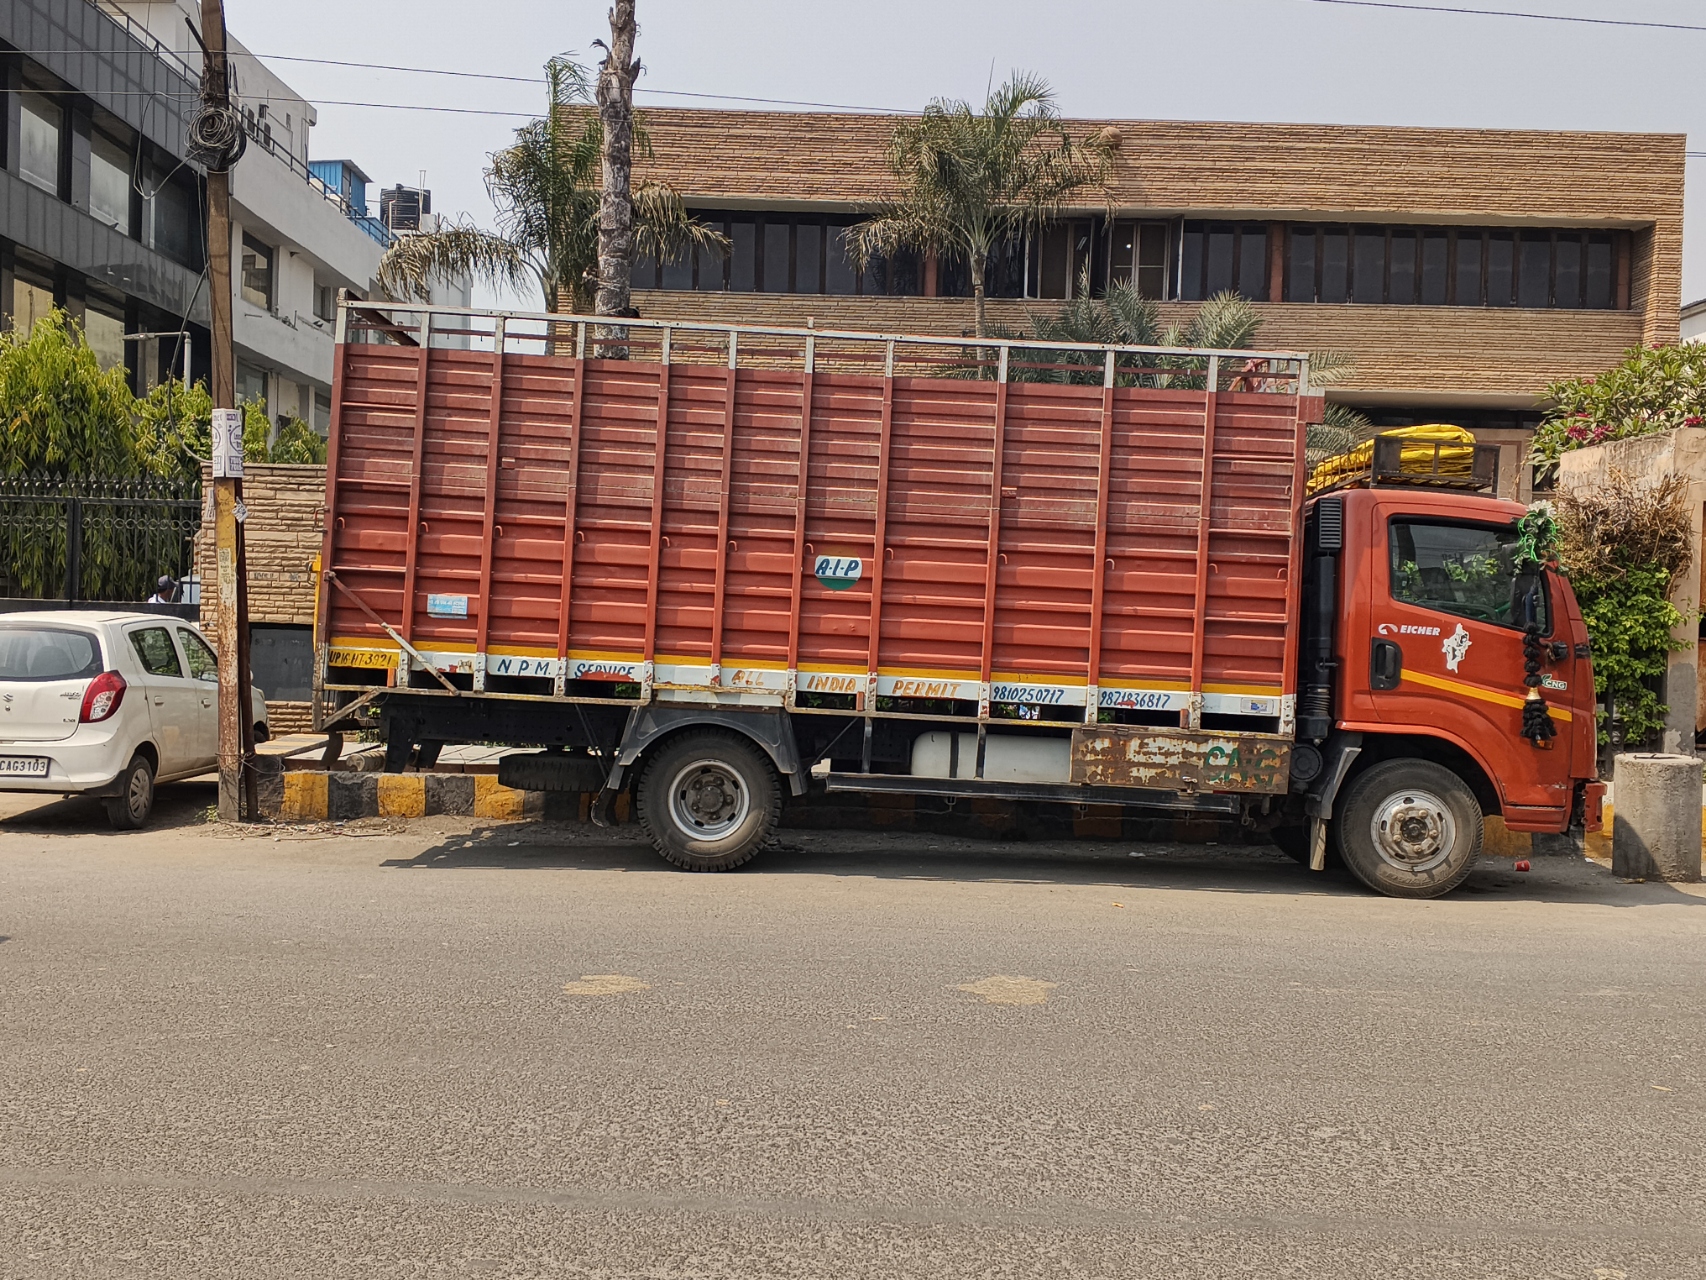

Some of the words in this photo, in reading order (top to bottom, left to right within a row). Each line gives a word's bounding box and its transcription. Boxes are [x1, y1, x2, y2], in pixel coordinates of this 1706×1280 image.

[1400, 624, 1441, 636] EICHER
[731, 669, 765, 686] ALL
[807, 675, 857, 693] INDIA
[892, 679, 962, 697] PERMIT
[1545, 680, 1566, 689] CNG
[993, 685, 1065, 704] 9810250717
